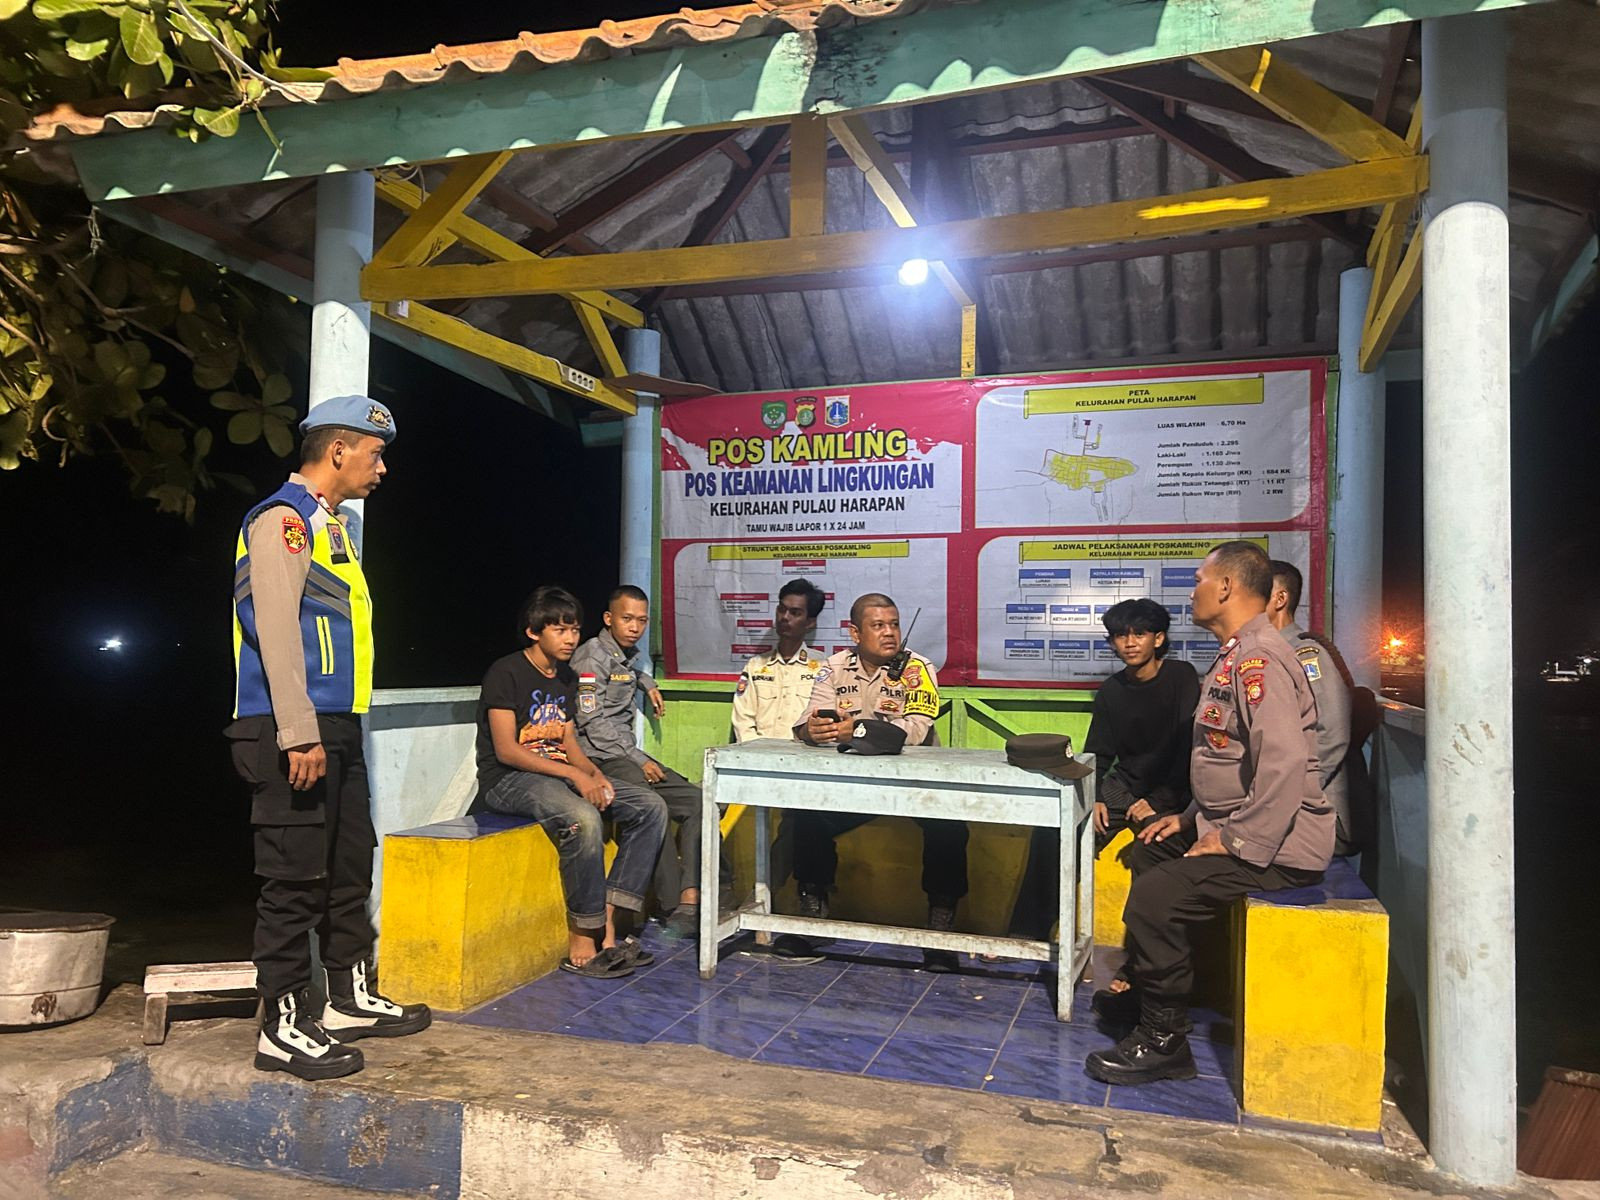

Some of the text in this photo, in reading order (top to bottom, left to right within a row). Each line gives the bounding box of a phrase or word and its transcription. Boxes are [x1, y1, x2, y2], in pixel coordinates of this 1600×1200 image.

[1129, 389, 1149, 397] PETA
[1075, 395, 1196, 407] KELURAHAN PULAU HARAPAN
[708, 429, 909, 466] POS KAMLING
[1157, 451, 1186, 459] Laki-Laki
[1157, 471, 1180, 479] Jumlah
[1181, 471, 1205, 479] Kepala
[1206, 470, 1235, 478] Keluarga
[1236, 469, 1252, 477] (KK)
[685, 463, 934, 498] POS KEAMANAN LINGKUNGAN
[1157, 481, 1180, 489] Jumlah
[1236, 479, 1250, 487] (RT)
[1157, 491, 1180, 499] Jumlah
[1226, 489, 1242, 497] (RW)
[710, 496, 906, 517] KELURAHAN PULAU HARAPAN
[746, 521, 866, 533] TAMU WAJIB LAPOR 1 X 24 JAM
[742, 545, 779, 553] STRUKTUR
[780, 544, 823, 552] ORGANISASI
[1053, 541, 1210, 551] JADWAL PELAKSANAAN POSKAMLING
[1208, 686, 1232, 702] POLRI
